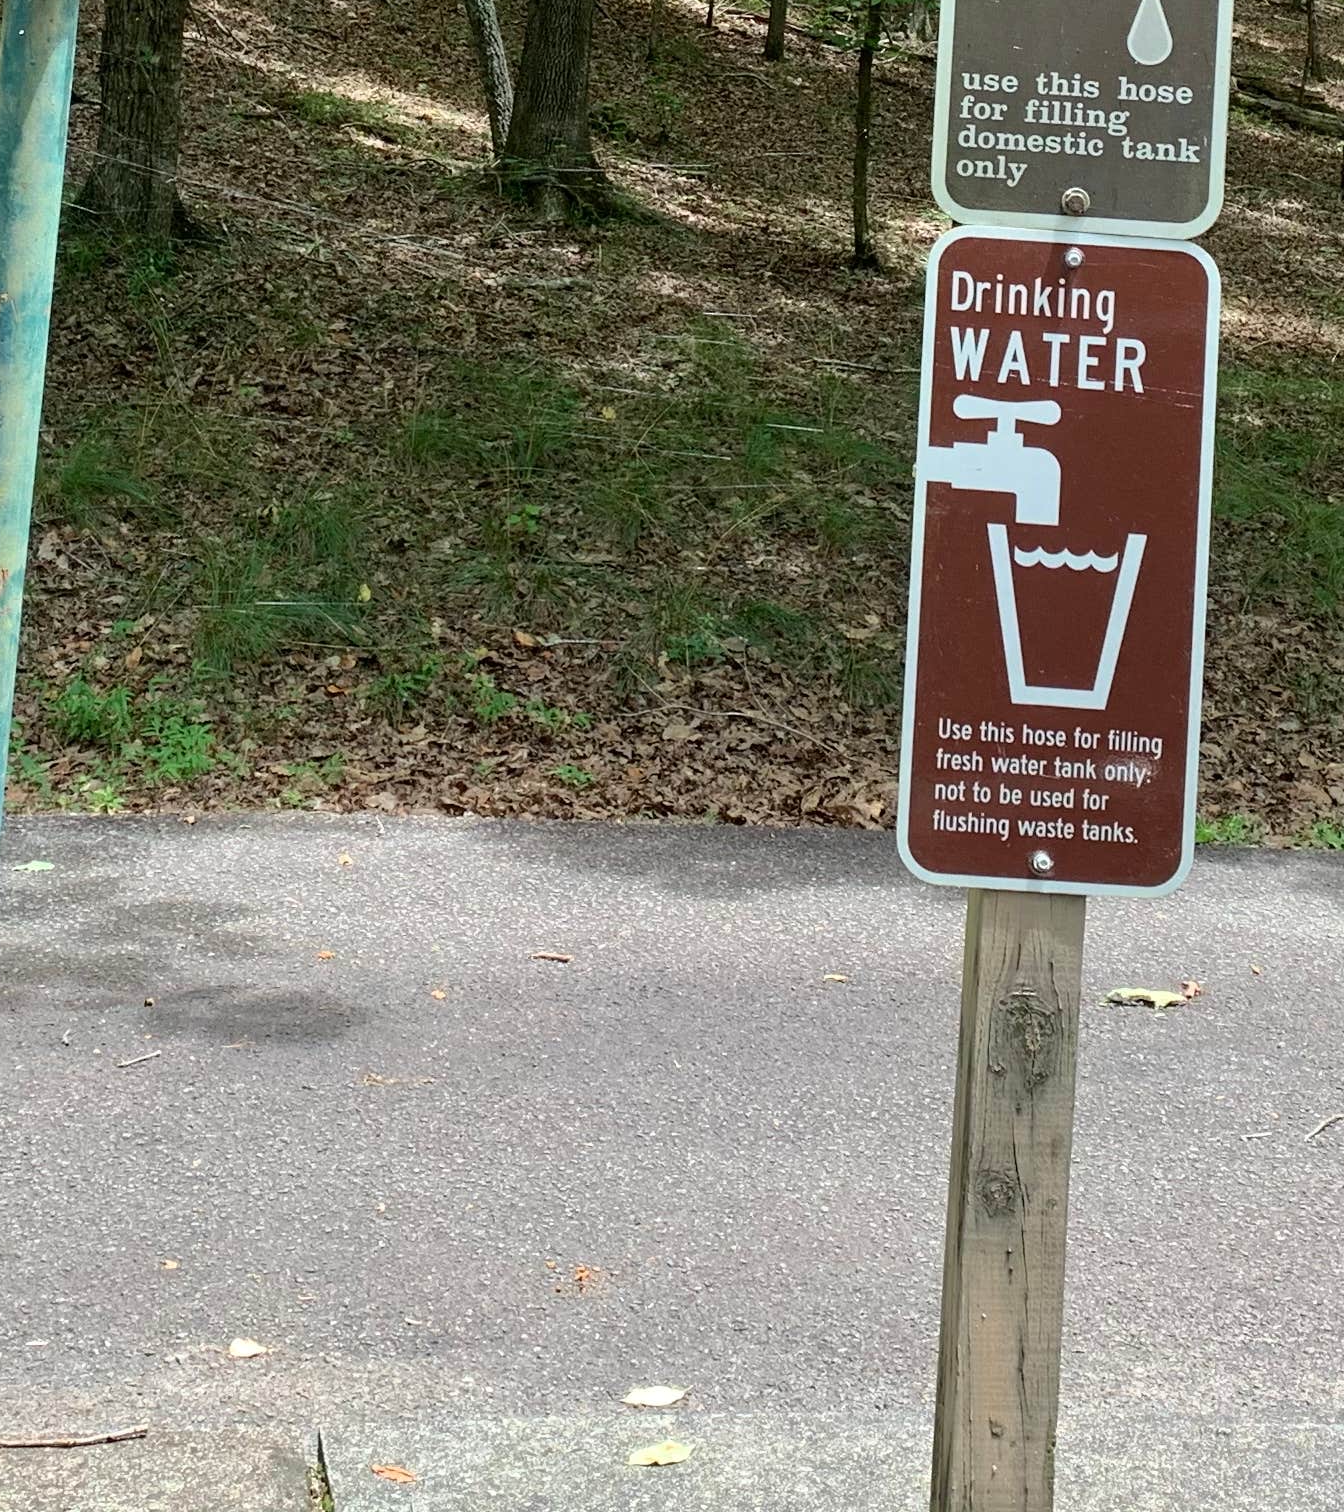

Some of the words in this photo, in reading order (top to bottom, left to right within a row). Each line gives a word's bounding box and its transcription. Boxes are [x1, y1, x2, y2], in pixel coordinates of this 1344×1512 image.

[961, 72, 1019, 93] use
[1035, 71, 1100, 99] this
[1117, 76, 1194, 105] hose
[959, 94, 1008, 121] for
[1023, 98, 1131, 138] filling
[957, 124, 1104, 157] domestic
[1121, 135, 1201, 163] tank
[956, 155, 1028, 188] only
[951, 270, 1116, 335] Drinking
[950, 325, 1147, 394] WATER
[938, 717, 973, 741] Use
[979, 720, 1015, 744] this
[1022, 723, 1067, 747] hose
[1073, 726, 1101, 750] for
[1107, 729, 1163, 761] filling
[935, 747, 984, 772] fresh
[991, 754, 1048, 777] water
[1053, 756, 1097, 780] tank
[934, 780, 966, 802] not
[972, 781, 992, 804] to
[999, 783, 1023, 805] be
[1030, 787, 1075, 809] used
[1082, 788, 1110, 811] for
[932, 808, 1010, 842] flushing
[1017, 817, 1075, 839] waste
[1081, 819, 1138, 844] tanks.
